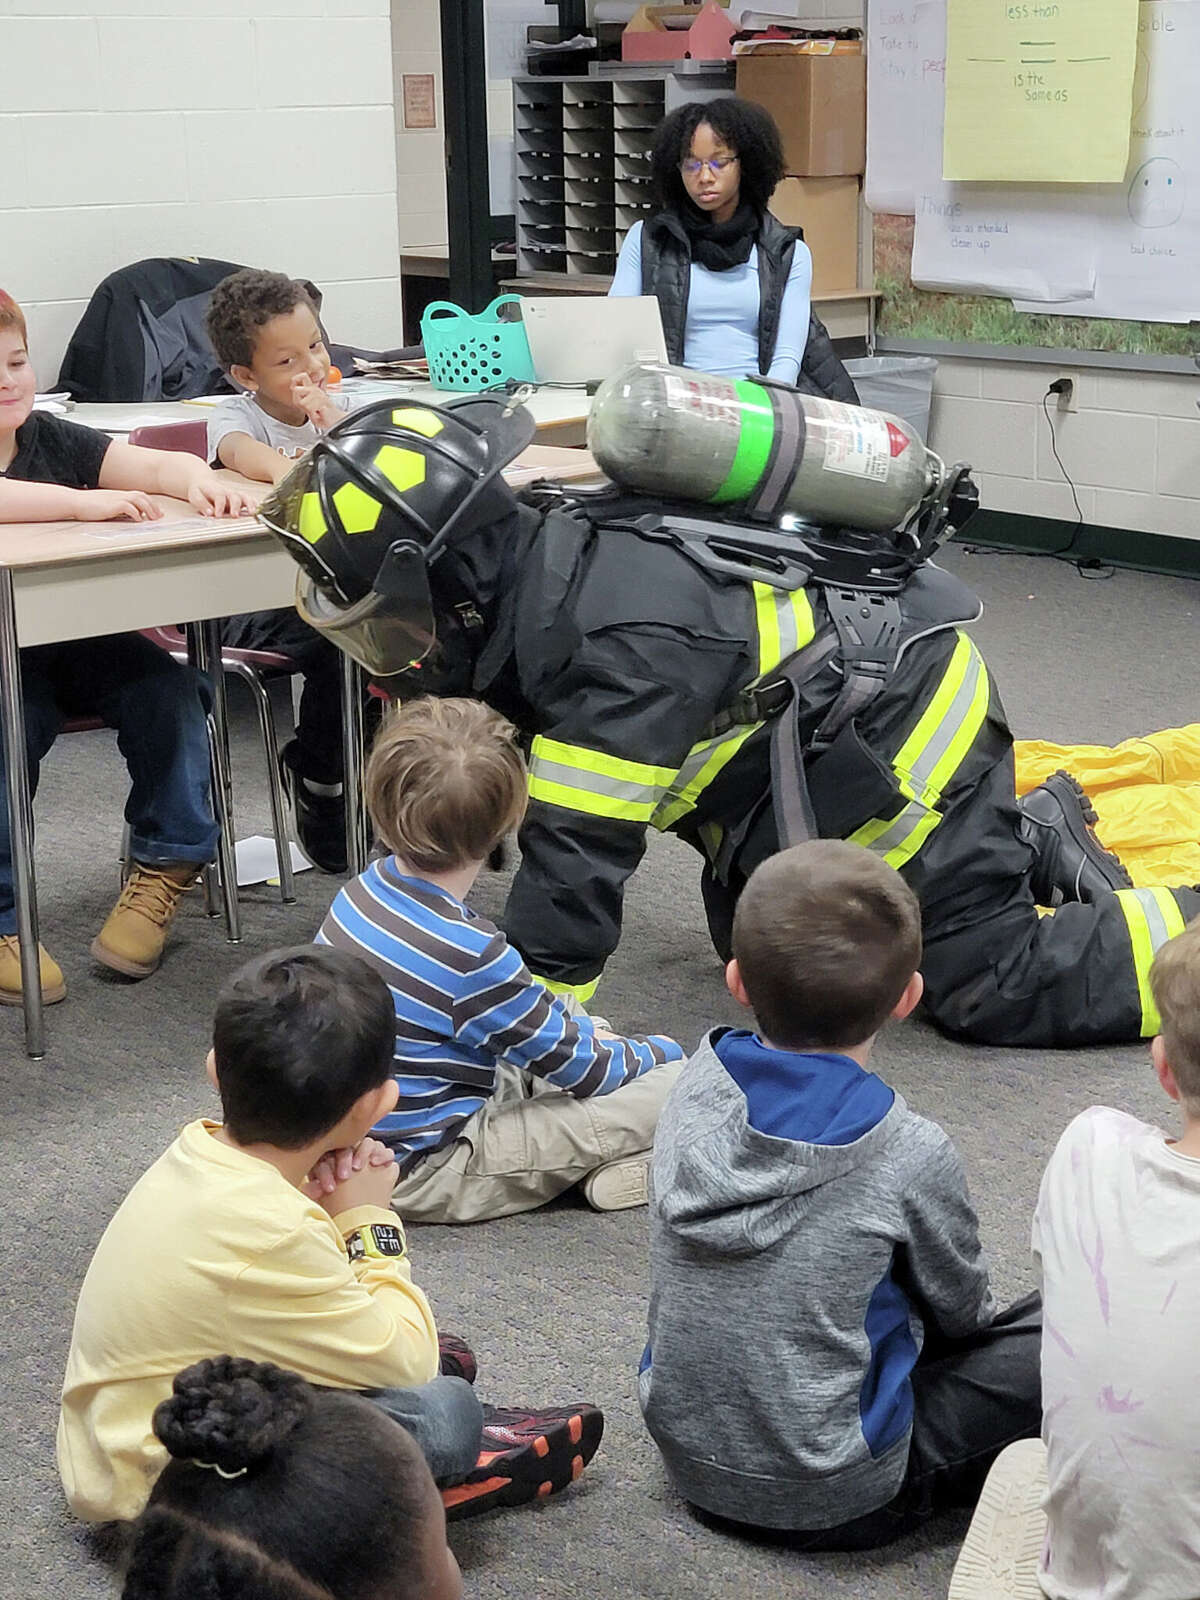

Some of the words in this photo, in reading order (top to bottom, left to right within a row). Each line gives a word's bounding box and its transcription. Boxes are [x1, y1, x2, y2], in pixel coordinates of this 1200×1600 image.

[1013, 74, 1025, 88] is
[1027, 71, 1045, 85] the
[1055, 88, 1069, 102] as
